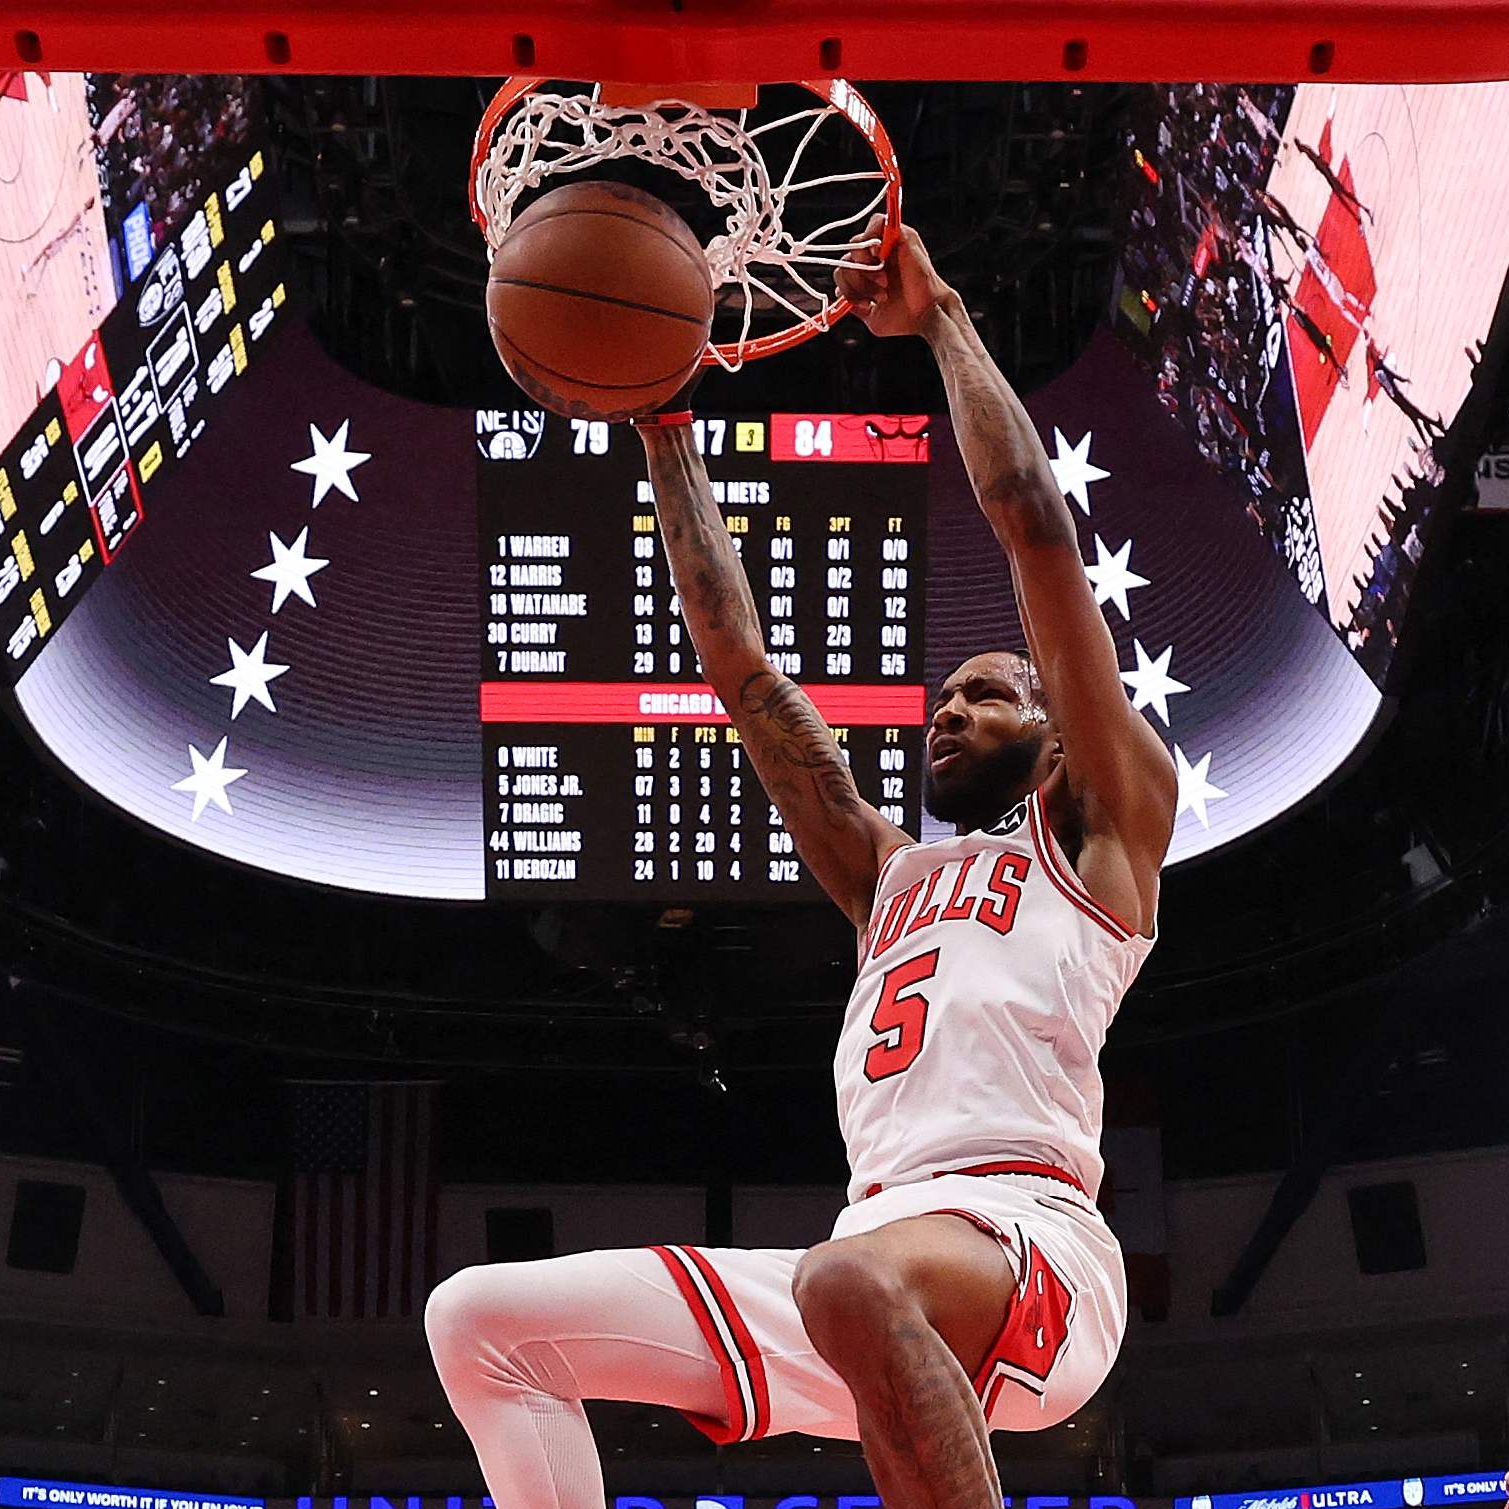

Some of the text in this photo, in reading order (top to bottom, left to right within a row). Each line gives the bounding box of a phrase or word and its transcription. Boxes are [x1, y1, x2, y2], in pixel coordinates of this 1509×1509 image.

[570, 418, 609, 455] 79
[794, 420, 833, 457] 84
[726, 481, 770, 504] NETS
[829, 516, 852, 532] 3PT
[888, 517, 903, 533] FT
[497, 535, 570, 558] 1 WARREN
[489, 564, 562, 587] 12 HARRIS
[489, 593, 588, 616] 18 WATANABE
[487, 622, 558, 644] 30 CURRY
[497, 650, 567, 673] 7 DURANT
[638, 692, 713, 715] CHICAGO
[498, 746, 559, 768] 0 WHITE
[498, 774, 584, 796] 5 JONES JR.
[498, 802, 564, 824] 7 DRAGIC
[489, 830, 582, 852] 44 WILLIAMS
[495, 858, 576, 880] 11 DEROZAN
[862, 945, 941, 1085] 5
[1312, 1489, 1373, 1508] ULTRA
